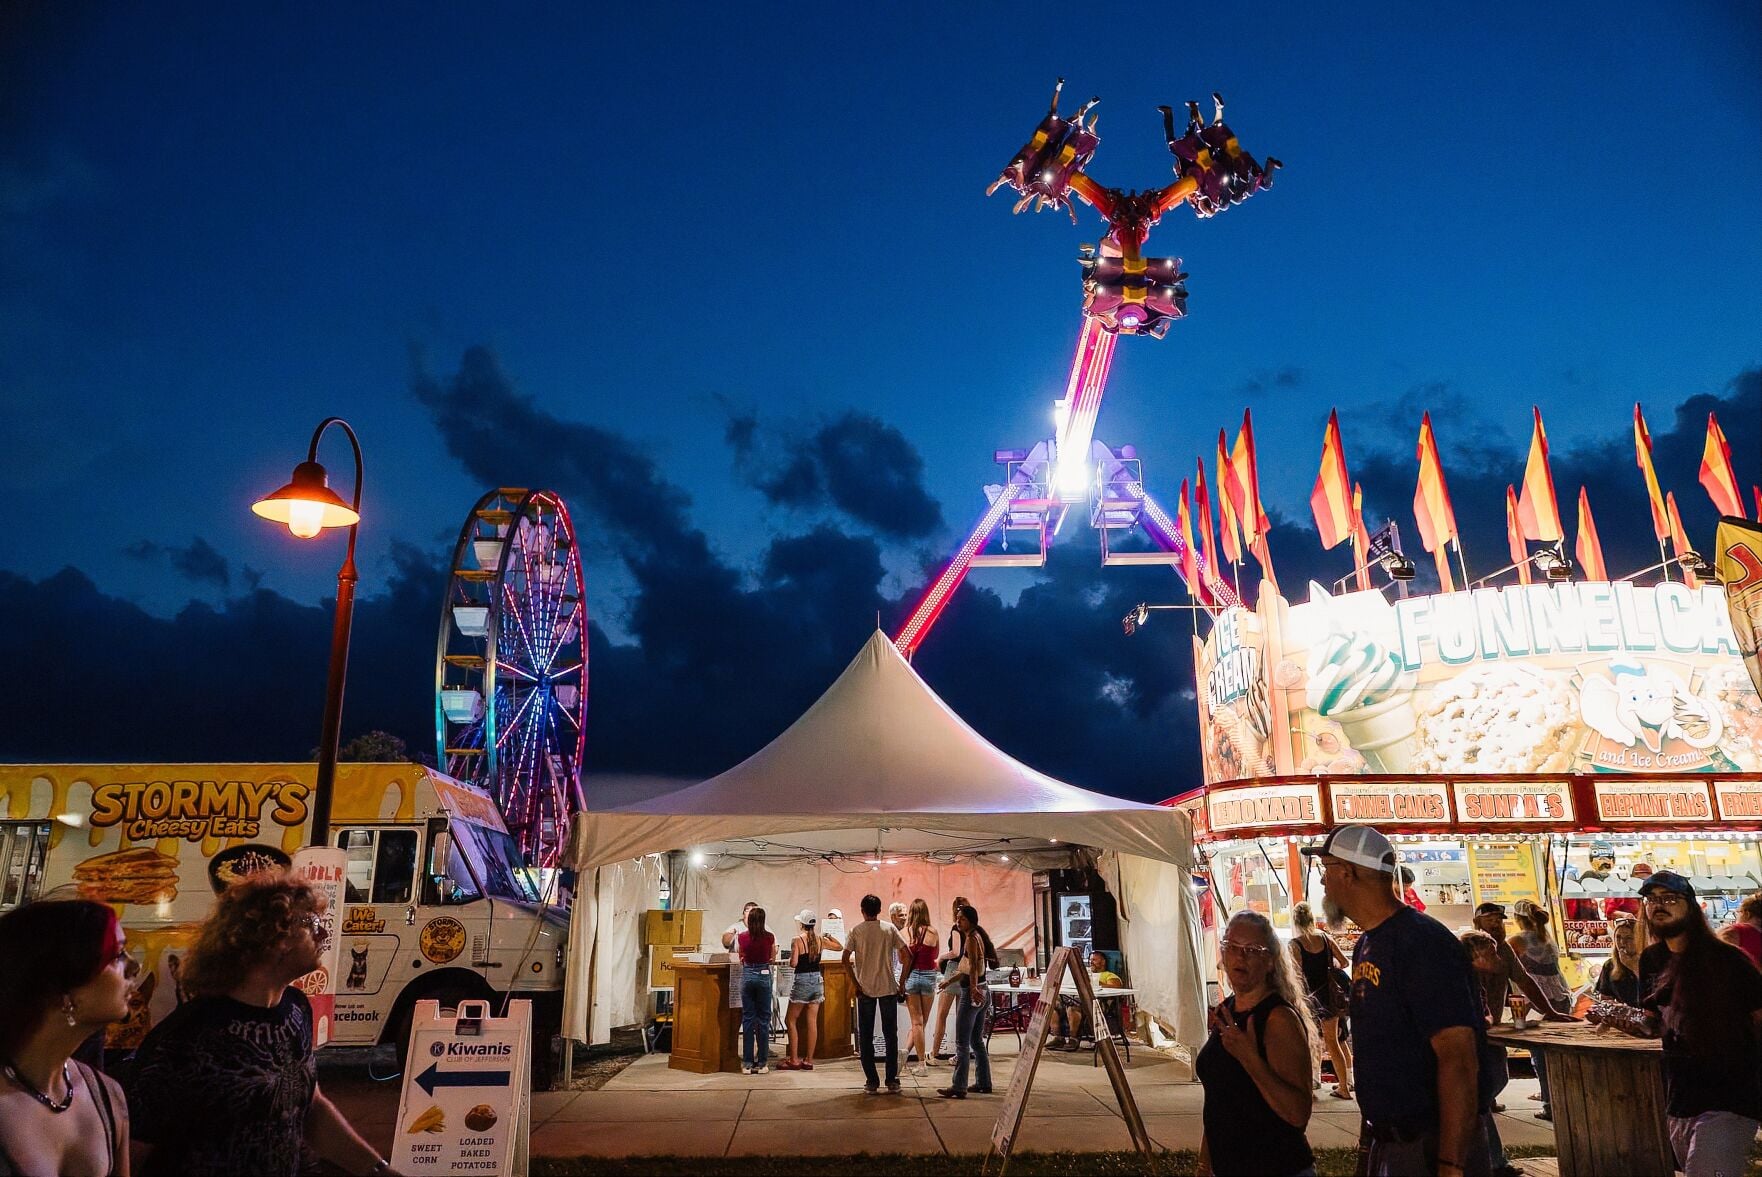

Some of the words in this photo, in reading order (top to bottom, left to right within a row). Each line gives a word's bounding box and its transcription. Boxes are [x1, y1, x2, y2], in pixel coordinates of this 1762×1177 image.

[1599, 748, 1629, 766] and
[1630, 752, 1651, 768] Ice
[90, 781, 310, 827] STORMY'S
[1213, 796, 1315, 826] LEMONADE
[1336, 794, 1394, 819] FUNNEL
[1393, 794, 1445, 819] CAKES
[1600, 793, 1669, 817] ELEPHANT
[1669, 792, 1709, 817] EARS
[1721, 792, 1762, 816] FRIE
[127, 818, 207, 843] Cheesy
[210, 816, 261, 839] Eats
[350, 907, 376, 921] We
[342, 919, 386, 933] Cater!
[333, 1010, 380, 1021] acebook
[447, 1041, 512, 1056] Kiwanis
[411, 1144, 442, 1153] SWEET
[459, 1138, 494, 1146] LOADED
[412, 1156, 438, 1164] CORN
[460, 1149, 491, 1158] BAKED
[451, 1161, 497, 1170] POTATOES
